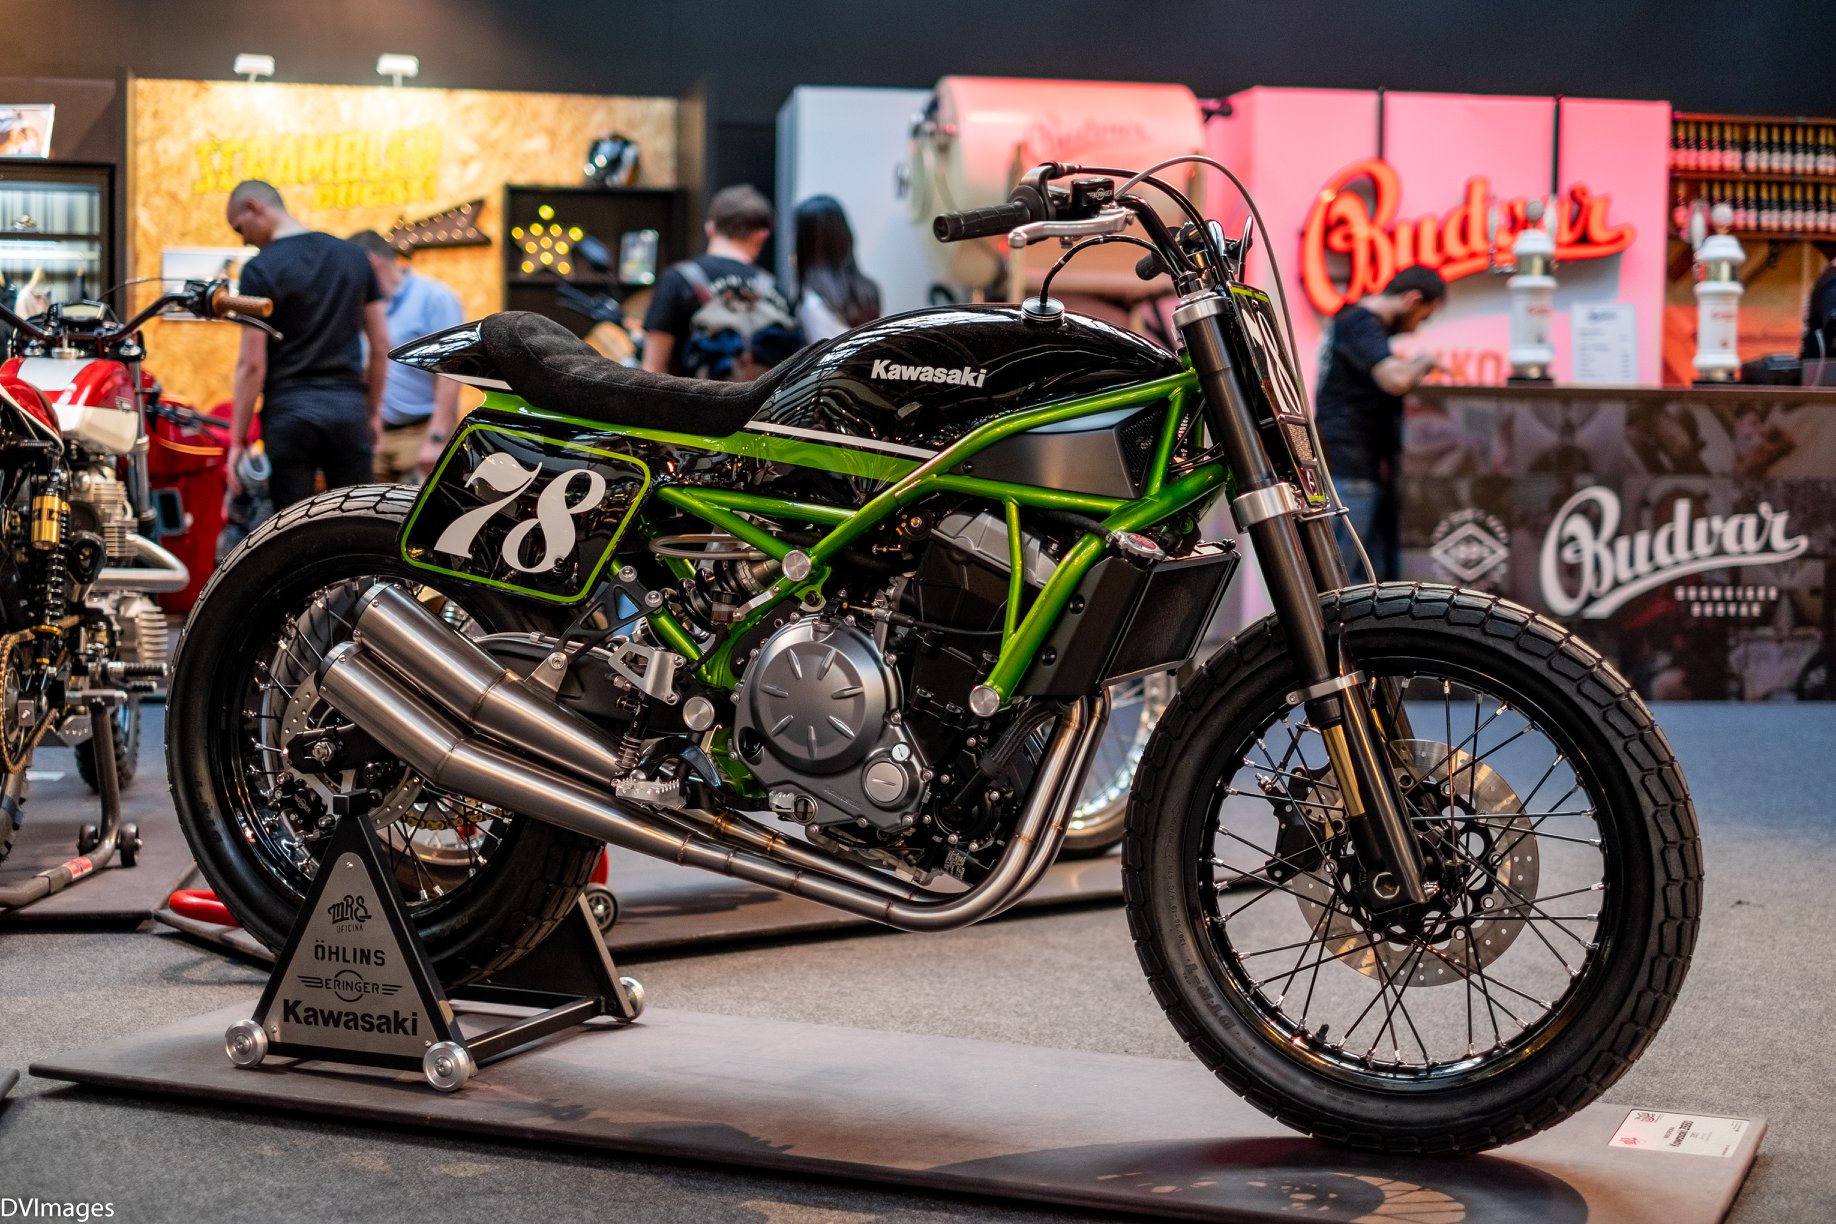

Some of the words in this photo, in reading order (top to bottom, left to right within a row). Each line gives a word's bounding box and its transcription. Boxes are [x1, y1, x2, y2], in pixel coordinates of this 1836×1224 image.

[871, 359, 987, 388] Kawasaki
[433, 452, 606, 573] 78
[1540, 486, 1808, 619] Budvar
[328, 895, 372, 924] MRS
[336, 923, 364, 934] OFICINA
[314, 939, 386, 967] ÖHLINS
[298, 975, 380, 994] BERINGER
[283, 999, 418, 1036] Kawasaki
